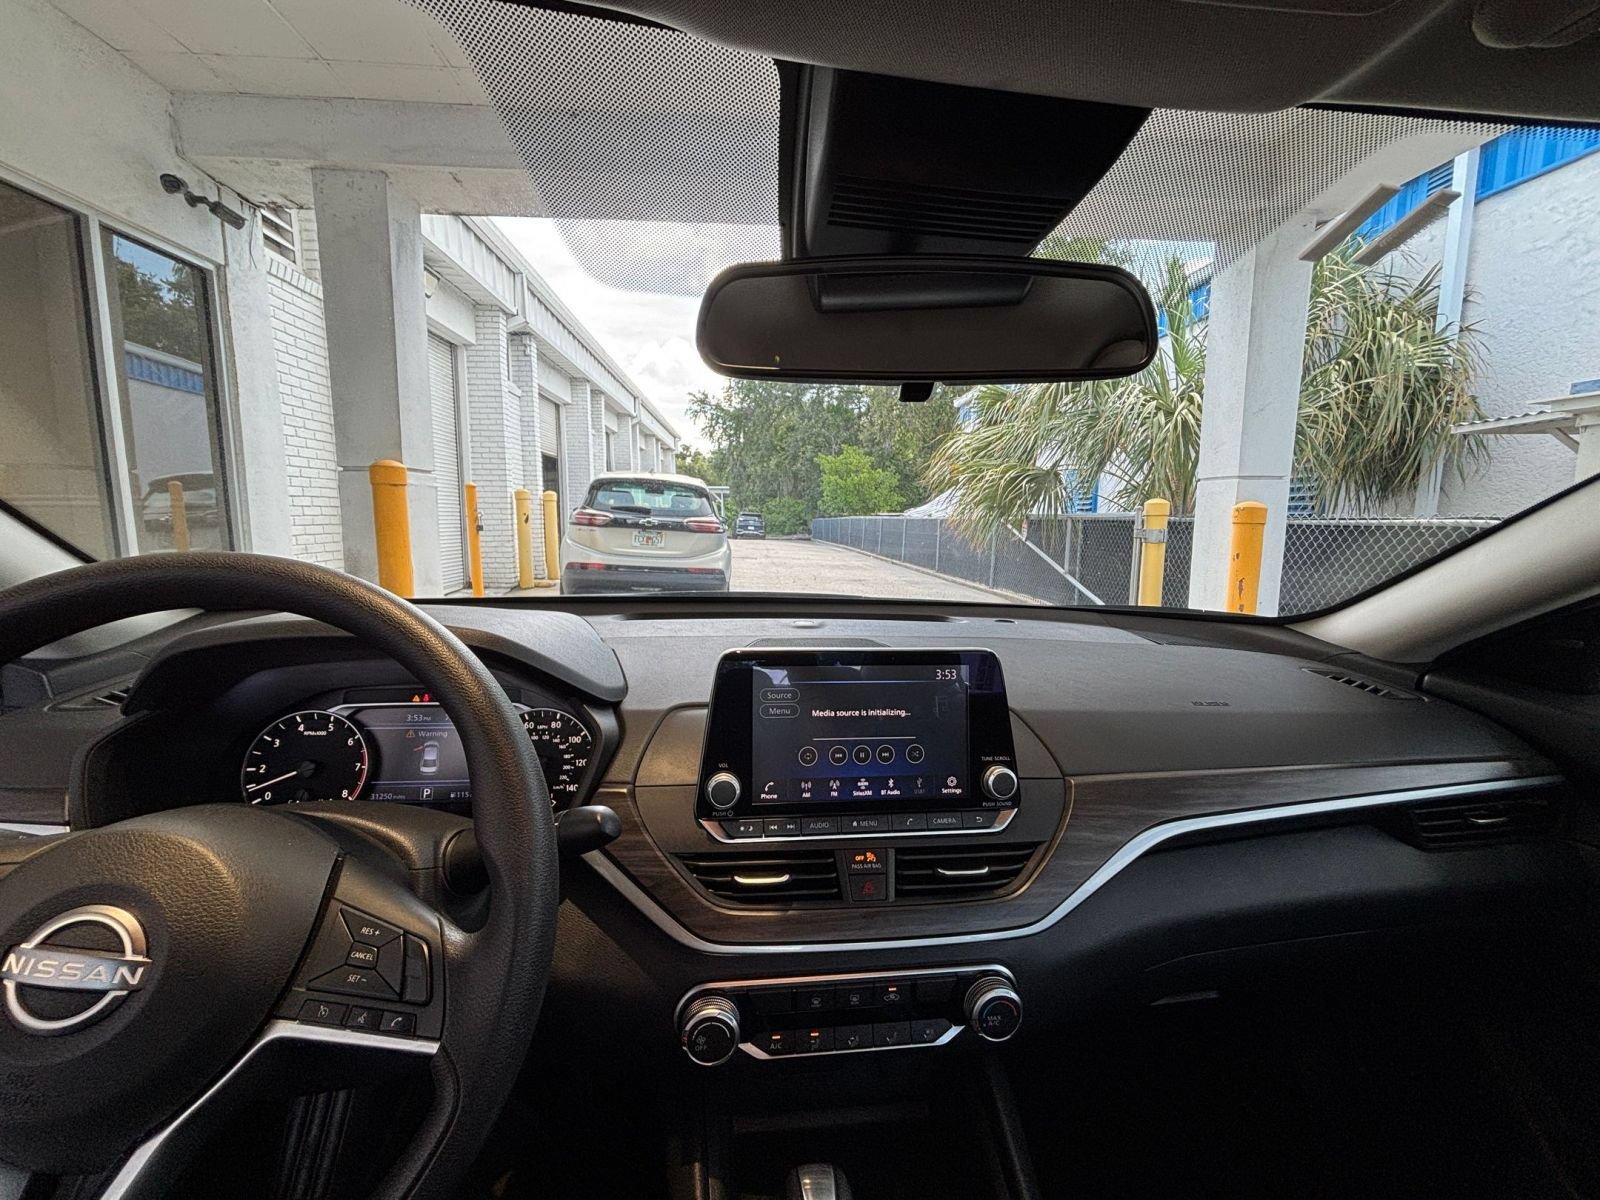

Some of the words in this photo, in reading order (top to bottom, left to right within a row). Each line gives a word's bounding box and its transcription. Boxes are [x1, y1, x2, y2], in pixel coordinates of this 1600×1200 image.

[935, 669, 957, 680] 3:53
[767, 691, 793, 700] Source
[769, 708, 791, 716] Menu
[811, 709, 834, 718] Media
[836, 710, 860, 718] source
[861, 709, 867, 717] is
[298, 723, 305, 732] 4
[328, 723, 334, 732] 5
[551, 721, 561, 729] 80
[418, 730, 448, 738] Warning
[273, 738, 280, 748] 3
[347, 738, 354, 746] 6
[259, 764, 266, 773] 2
[355, 762, 361, 771] 7
[264, 791, 271, 800] 0
[341, 789, 348, 798] 8
[423, 788, 431, 799] P
[810, 821, 829, 829] AUDIO
[350, 951, 374, 961] CANCEL
[2, 953, 145, 985] NISSAN
